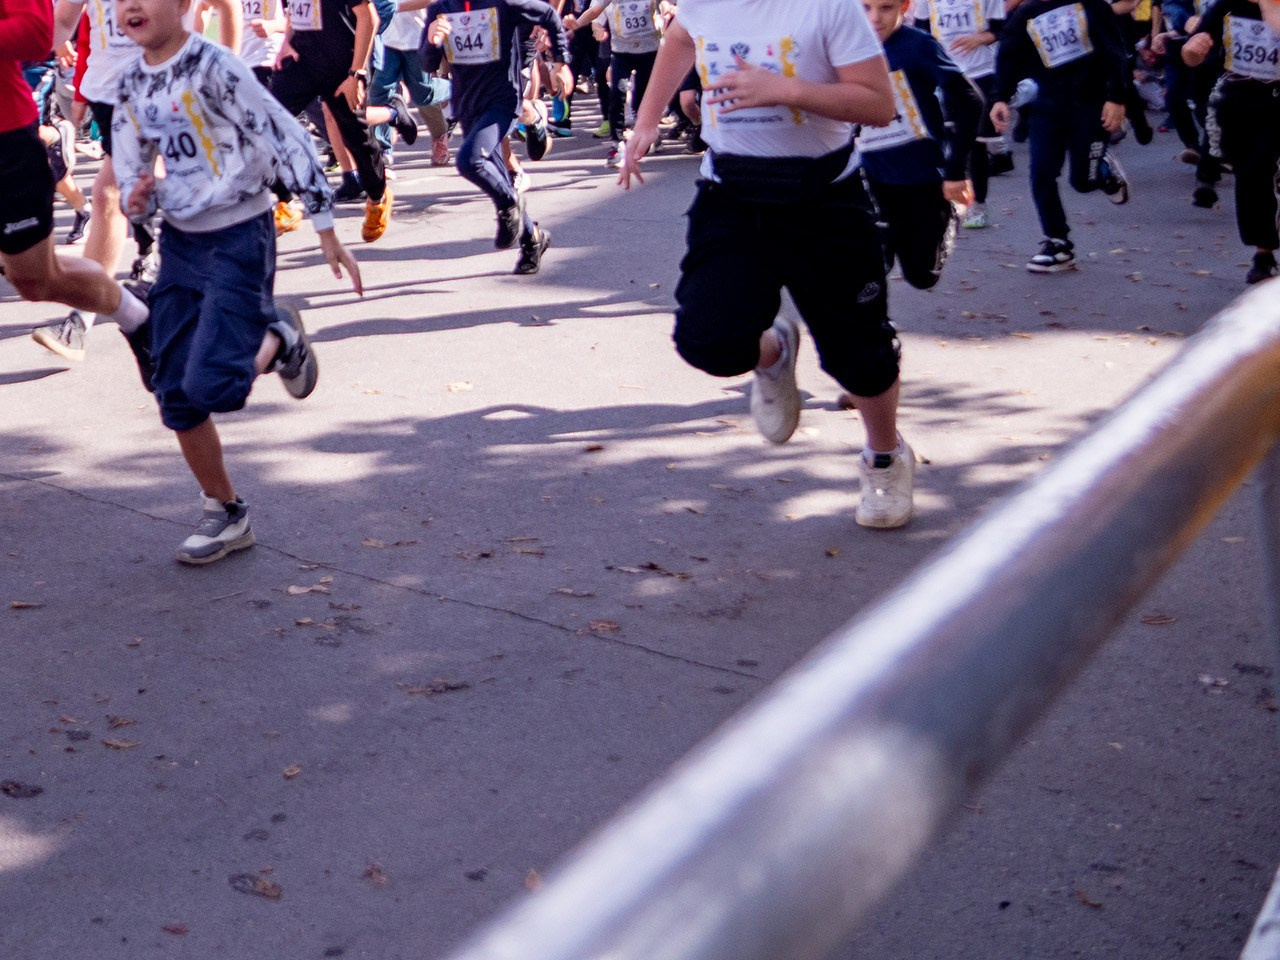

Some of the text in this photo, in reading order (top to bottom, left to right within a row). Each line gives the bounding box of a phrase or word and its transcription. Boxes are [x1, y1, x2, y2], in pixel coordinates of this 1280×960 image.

[625, 16, 647, 29] 633
[938, 12, 971, 28] 4711
[455, 33, 484, 51] 644
[1233, 42, 1279, 65] 2594
